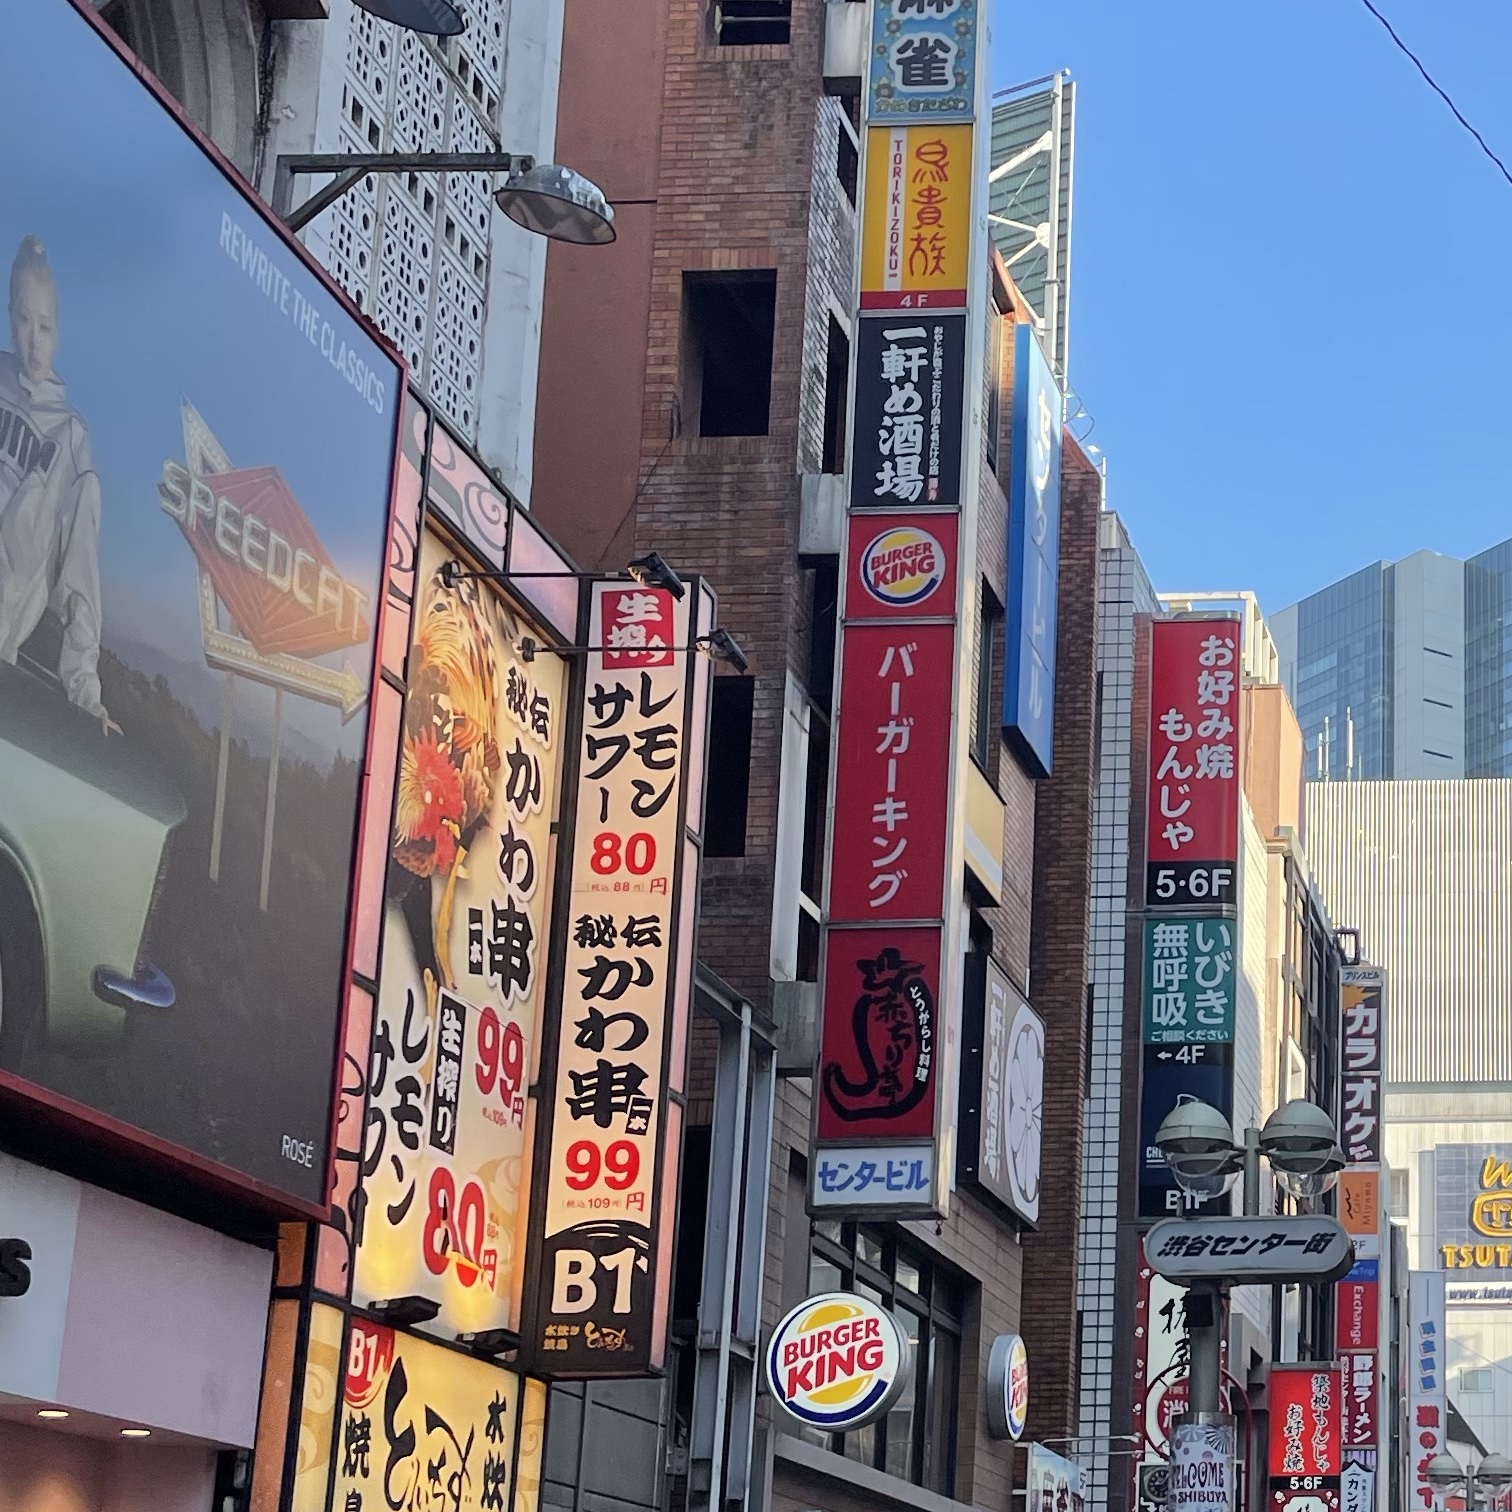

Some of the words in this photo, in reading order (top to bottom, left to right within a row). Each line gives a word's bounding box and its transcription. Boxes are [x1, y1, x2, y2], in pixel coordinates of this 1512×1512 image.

[896, 0, 953, 87] 雀
[218, 210, 291, 318] REWRITE
[291, 292, 322, 352] THE
[320, 315, 386, 416] CLASSICS
[900, 294, 928, 307] 4F
[873, 326, 929, 502] 一軒め酒場
[158, 458, 371, 640] SPEEDCAT
[870, 541, 933, 571] BURGER
[872, 553, 936, 589] KING
[1195, 634, 1235, 780] お好み焼
[584, 682, 635, 825] サワー
[630, 670, 680, 819] レモン
[868, 641, 919, 908] バーガーキング
[1156, 707, 1195, 851] もんじゃ
[589, 831, 657, 876] 80
[572, 913, 663, 950] 秘伝
[1152, 922, 1190, 1027] 無呼吸
[1194, 922, 1233, 1025] いびき
[474, 1005, 524, 1108] 99
[567, 954, 655, 1129] かわ串
[1175, 1045, 1206, 1065] 4F
[1344, 1003, 1379, 1144] カラオケ
[281, 1133, 314, 1169] ROSÉ
[564, 1139, 641, 1191] 99
[818, 1159, 930, 1193] センタービル
[1156, 1232, 1338, 1258] 渋谷センター街
[550, 1248, 637, 1315] B1
[1350, 1285, 1365, 1345] Exchange
[347, 1327, 378, 1384] B1
[783, 1316, 881, 1369] BURGER
[785, 1339, 885, 1401] KING
[1284, 1403, 1305, 1474] お好み焼
